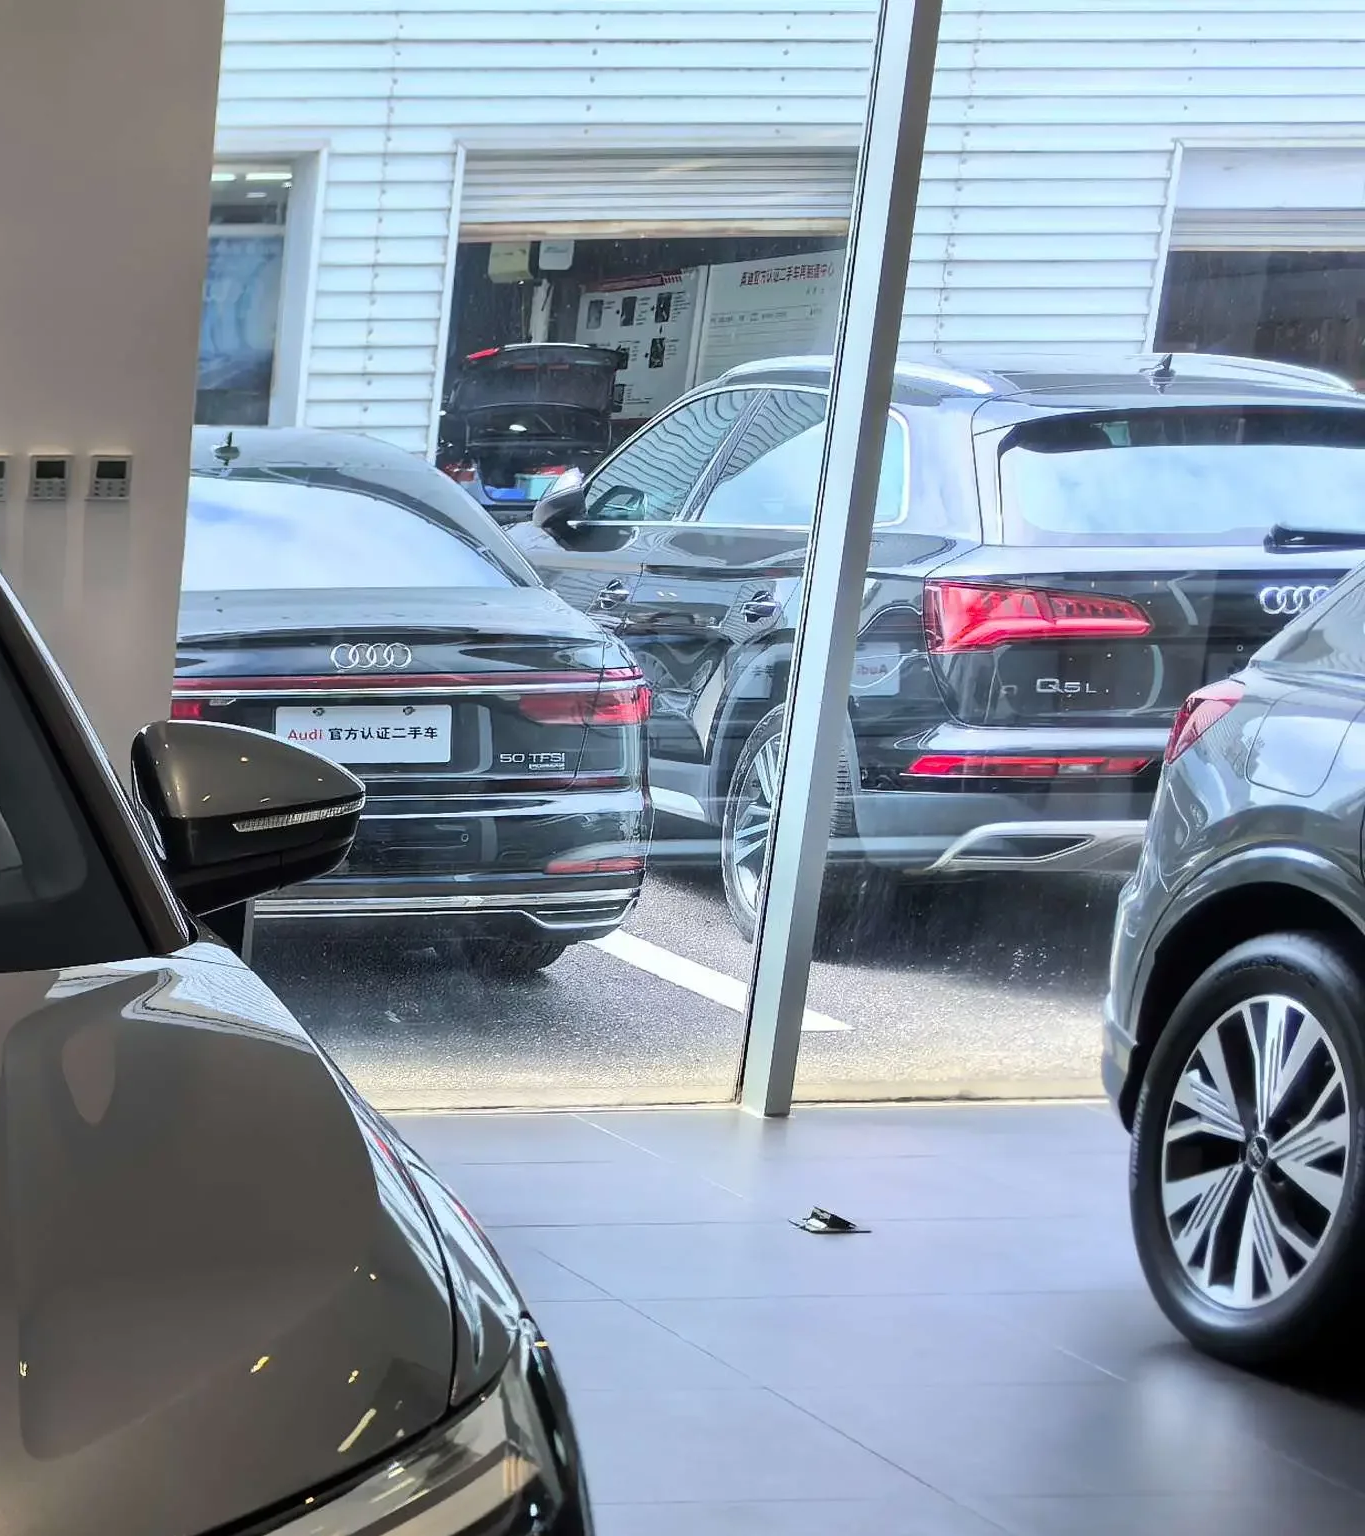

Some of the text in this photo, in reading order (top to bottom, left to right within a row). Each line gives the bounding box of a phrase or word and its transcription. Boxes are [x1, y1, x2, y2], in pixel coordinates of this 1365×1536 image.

[287, 727, 438, 741] Audi 官方认证二手车
[500, 752, 565, 763] 50 TFSI
